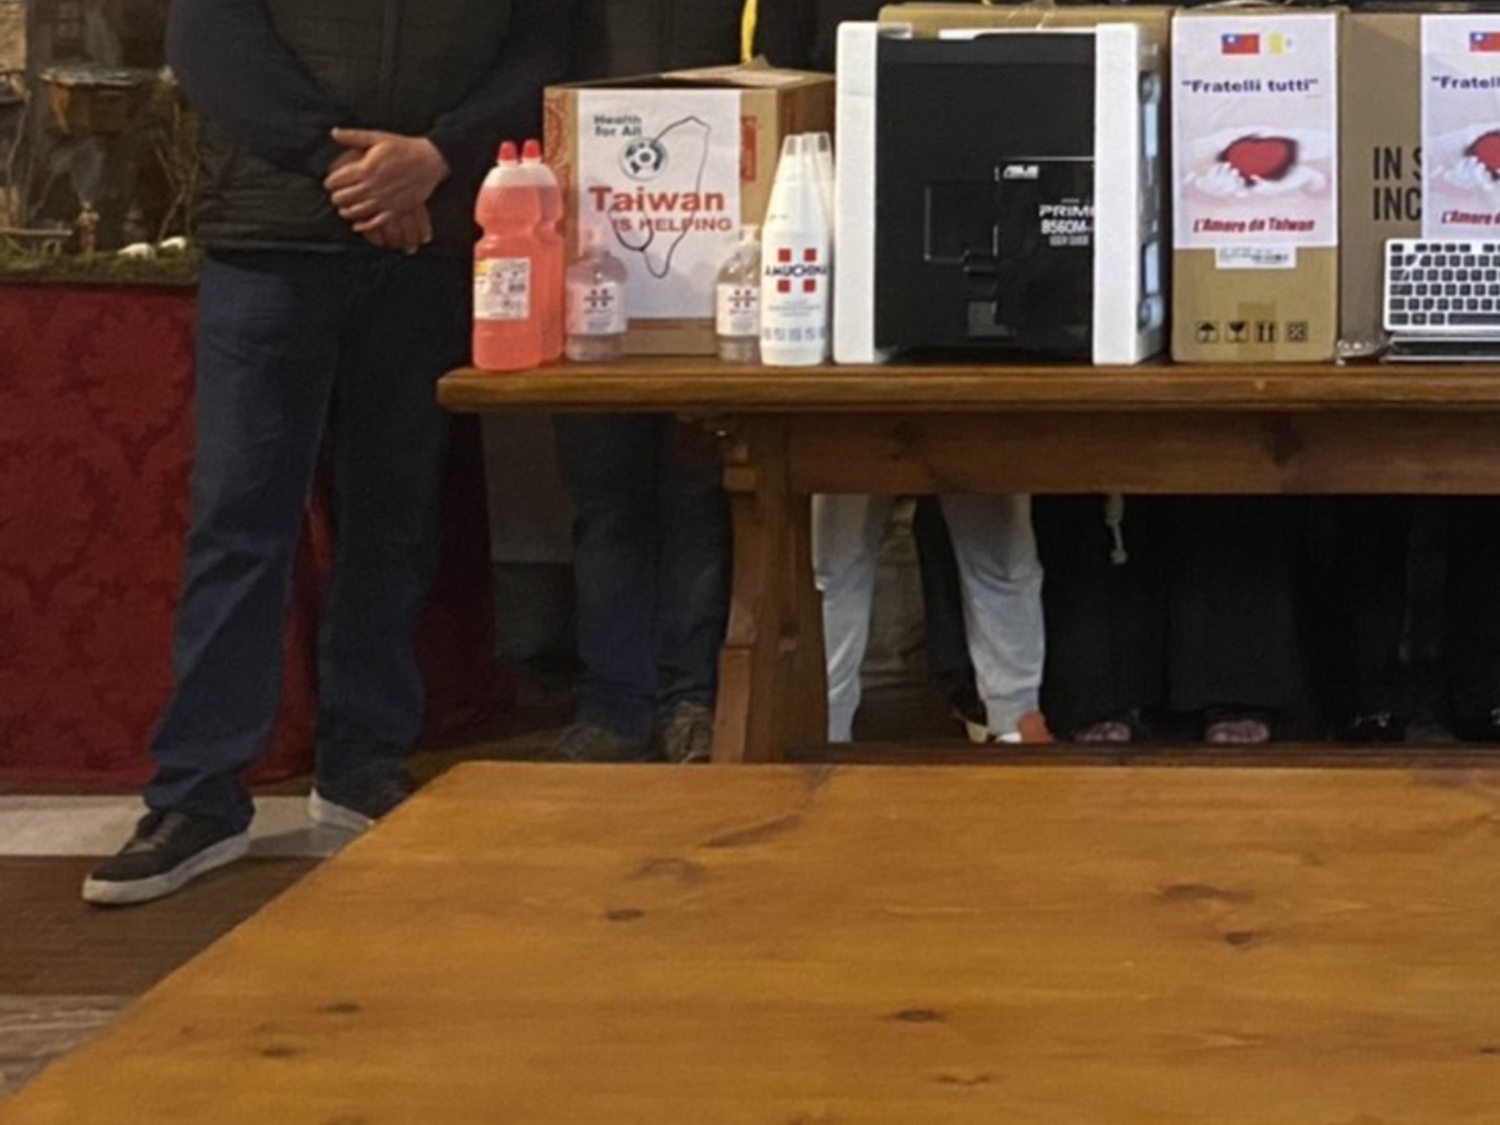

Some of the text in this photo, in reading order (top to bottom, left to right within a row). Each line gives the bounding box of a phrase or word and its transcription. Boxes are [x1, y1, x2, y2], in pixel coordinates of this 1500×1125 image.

[593, 114, 642, 125] Health
[595, 125, 642, 136] for All
[1373, 146, 1402, 181] IN
[587, 185, 725, 212] Taiwan
[1373, 186, 1422, 222] INC
[611, 217, 733, 232] IS HELPING
